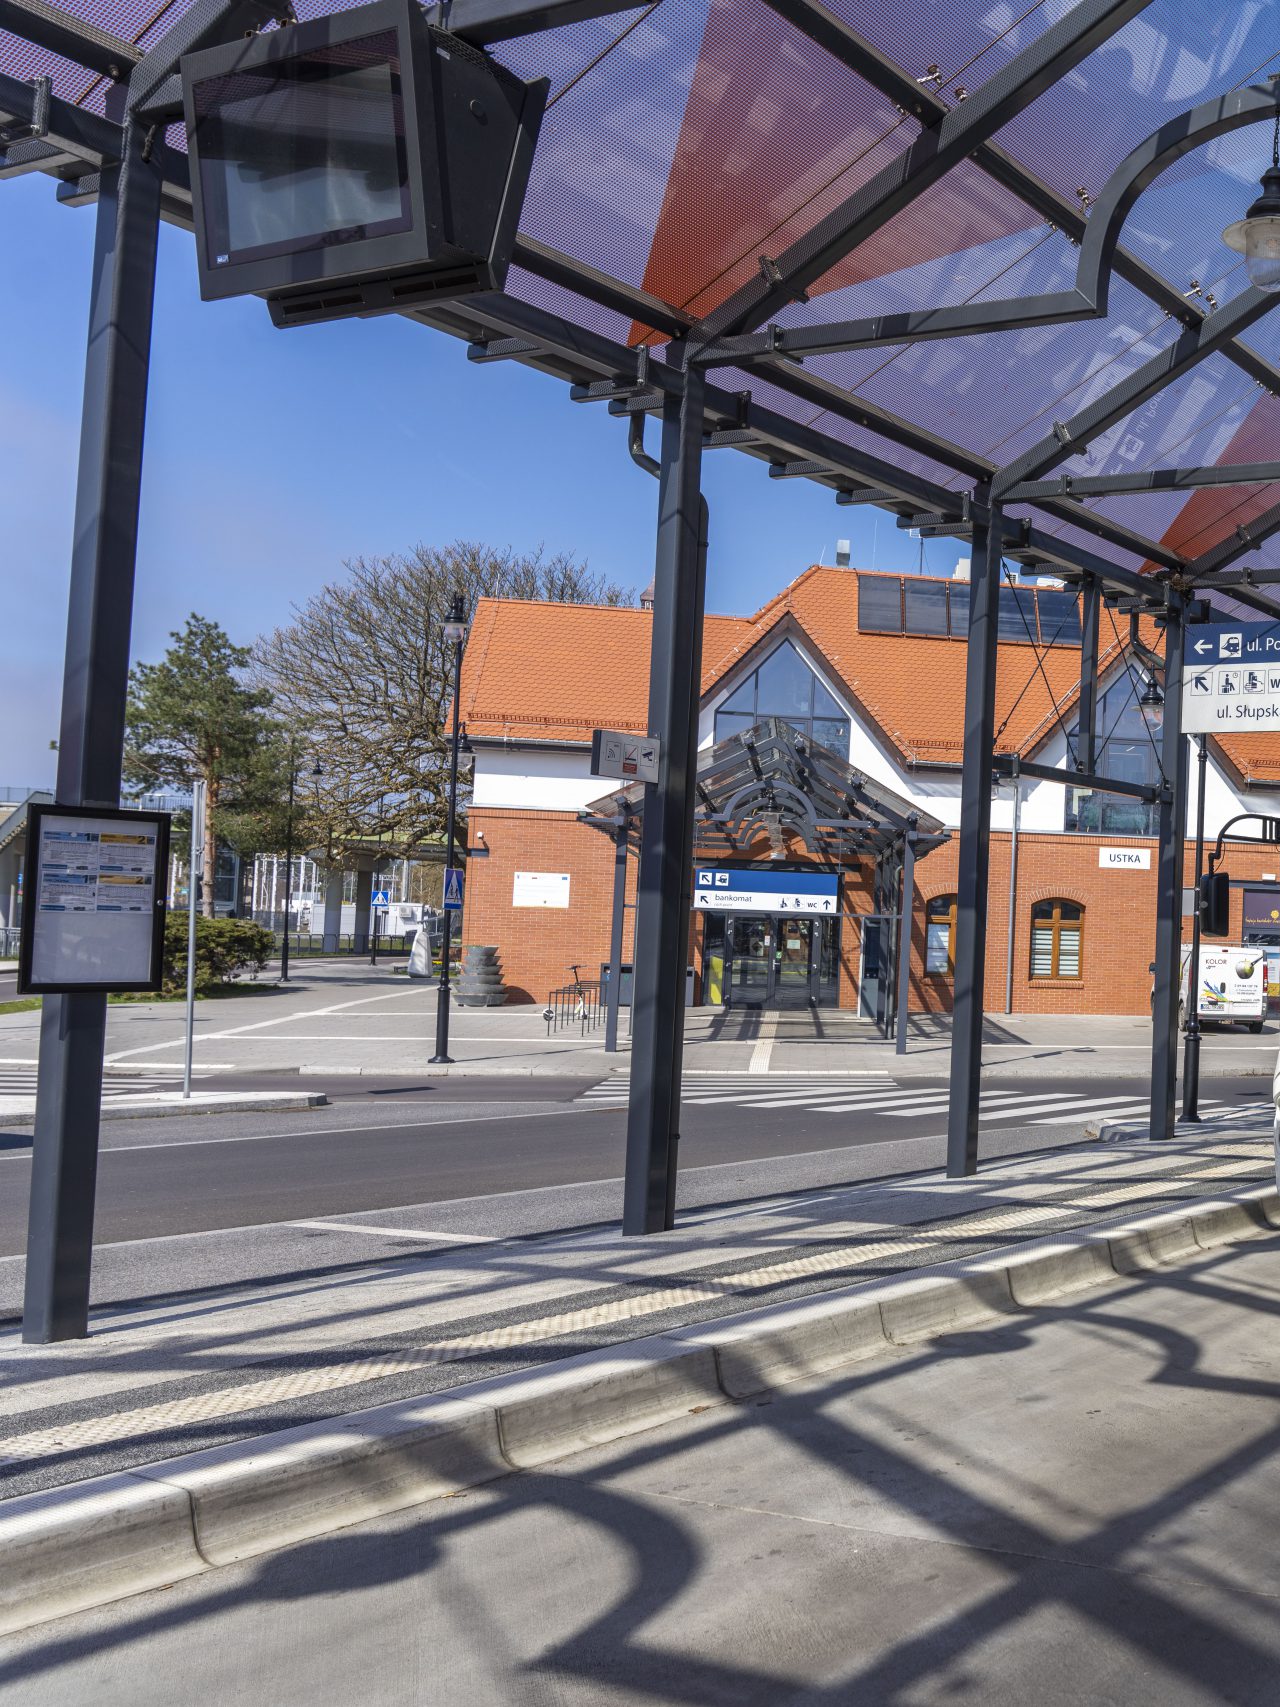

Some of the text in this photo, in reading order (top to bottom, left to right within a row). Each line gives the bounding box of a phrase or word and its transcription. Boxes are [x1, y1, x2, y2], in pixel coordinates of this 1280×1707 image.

[1246, 635, 1262, 652] ul.
[1217, 705, 1232, 719] ul.
[1109, 854, 1141, 863] USTKA
[714, 893, 752, 903] bankomat
